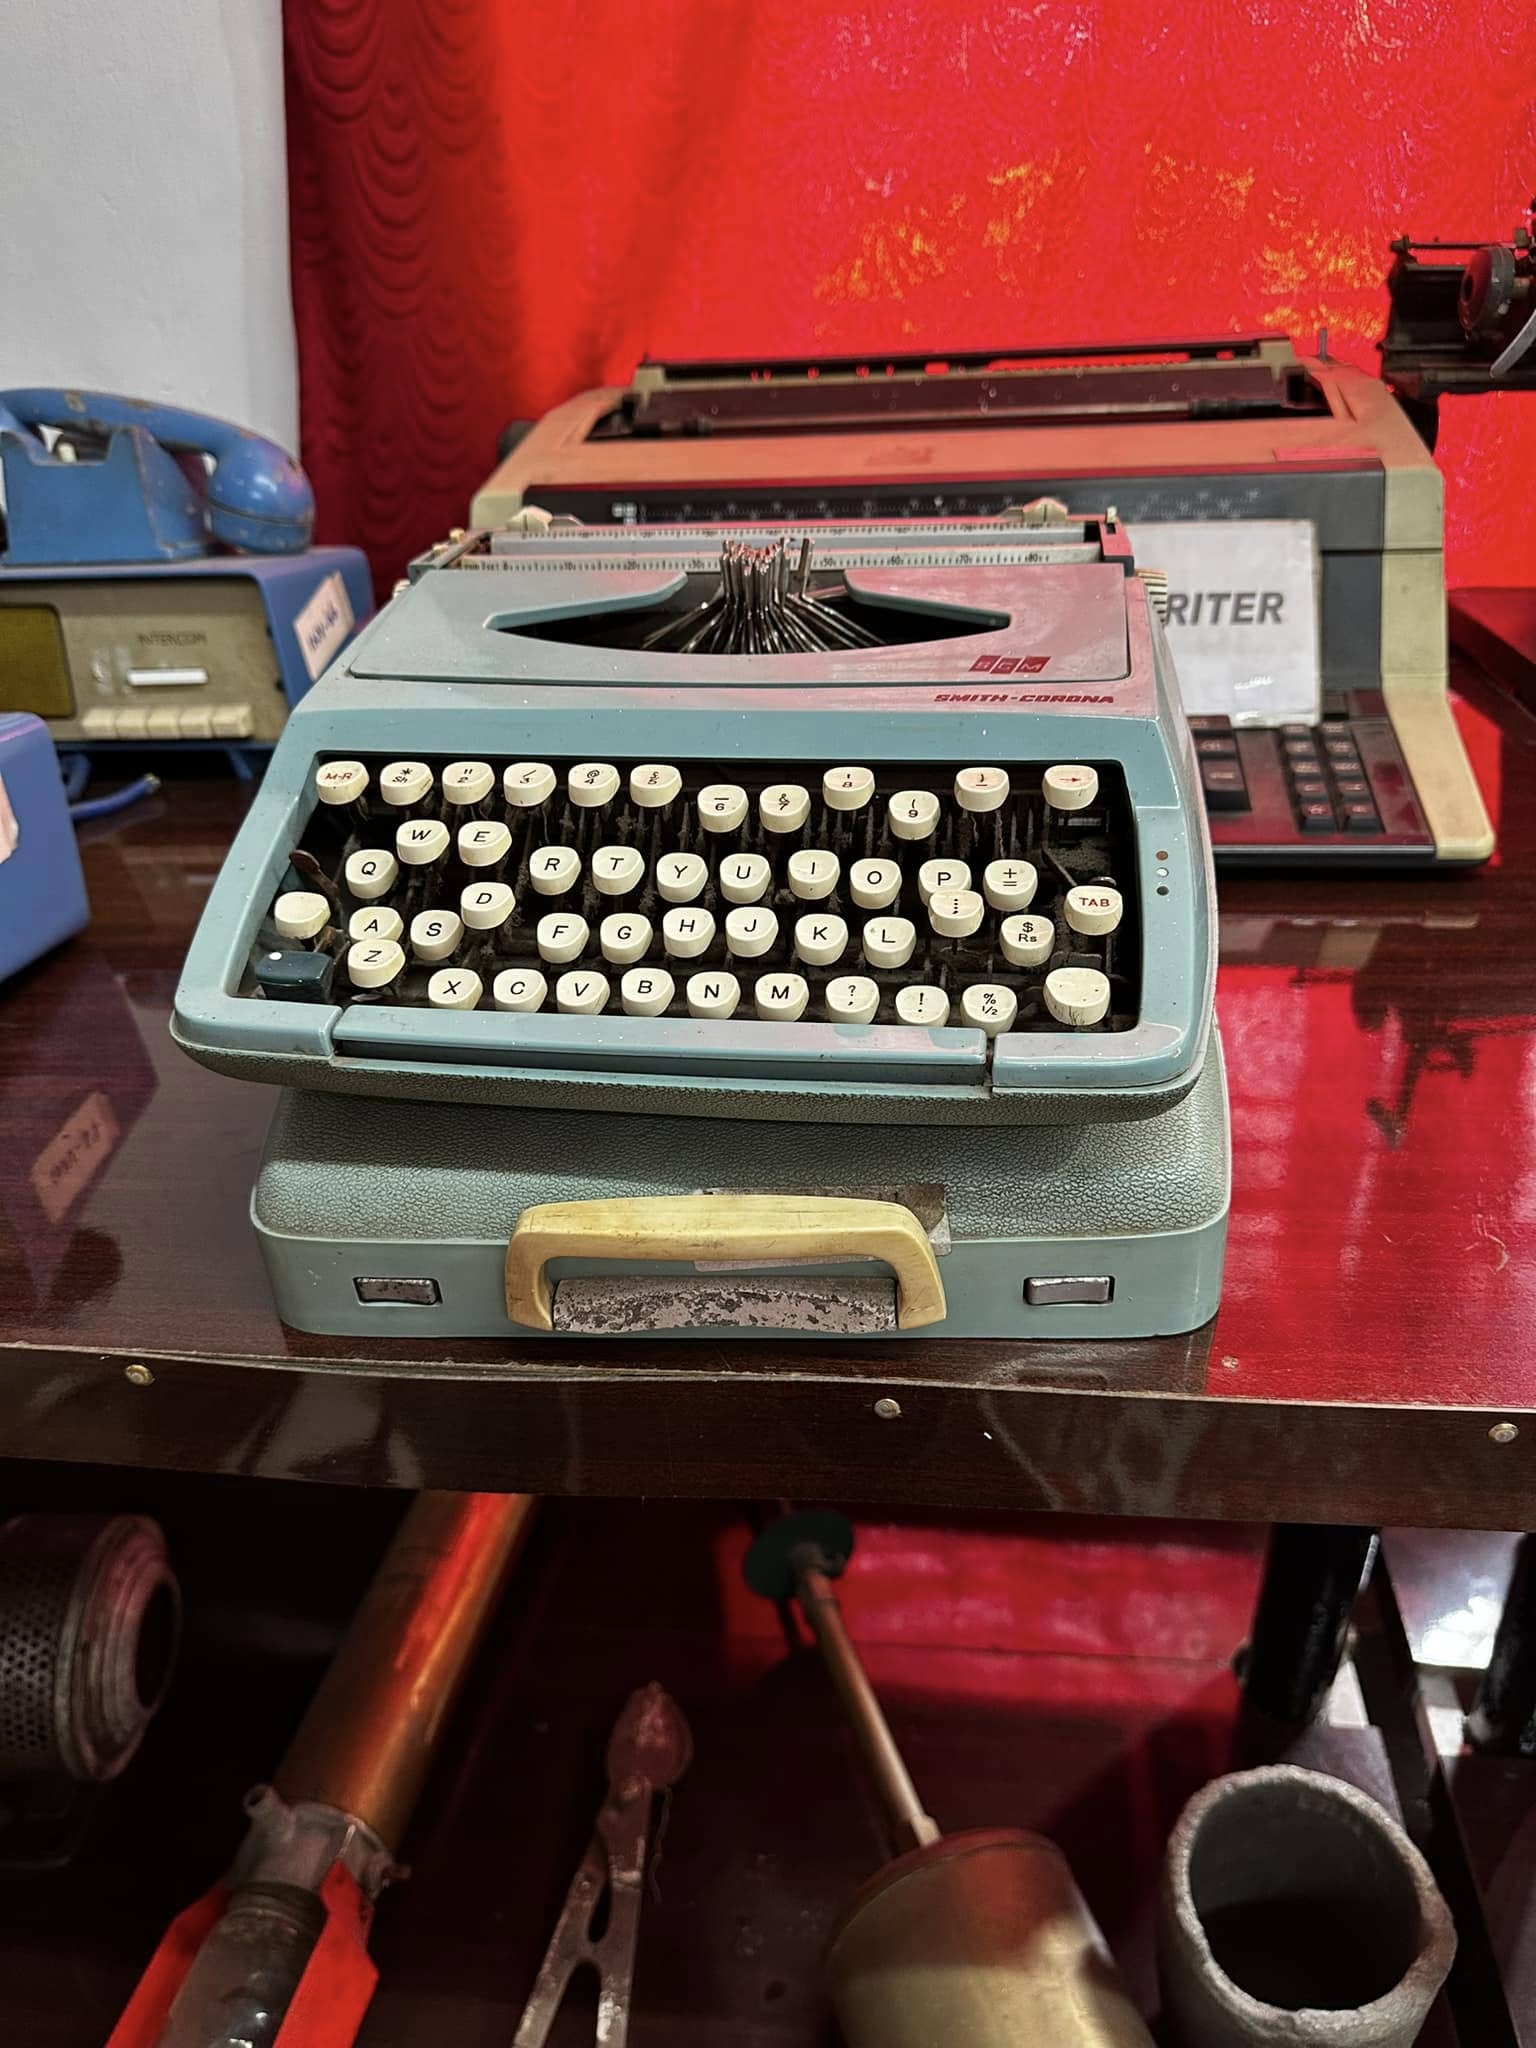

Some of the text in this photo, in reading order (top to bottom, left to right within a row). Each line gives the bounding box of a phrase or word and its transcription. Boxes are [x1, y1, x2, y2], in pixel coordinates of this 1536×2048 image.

[933, 693, 1115, 704] SMITH-CORONA
[586, 769, 601, 780] @
[714, 802, 725, 811] 6
[908, 809, 919, 818] 9
[411, 829, 432, 841] W
[472, 830, 491, 843] E
[361, 861, 377, 876] Q
[543, 857, 561, 872] R
[609, 857, 625, 871] T
[674, 864, 689, 879] Y
[811, 861, 816, 875] I
[736, 865, 752, 880] U
[866, 870, 883, 885] O
[937, 871, 952, 887] P
[475, 892, 493, 905] D
[1079, 897, 1110, 907] TAB
[363, 918, 379, 933] A
[425, 922, 443, 937] S
[551, 924, 569, 939] F
[617, 925, 632, 940] G
[679, 919, 696, 933] H
[743, 918, 757, 933] J
[1021, 921, 1035, 934] $
[812, 926, 828, 941] K
[881, 928, 896, 944] L
[1017, 933, 1038, 943] Rs
[362, 949, 383, 963] Z
[442, 980, 462, 995] X
[510, 981, 526, 996] C
[574, 982, 590, 997] V
[637, 979, 653, 994] B
[703, 983, 720, 999] N
[770, 985, 790, 1000] M
[847, 984, 858, 998] ?
[919, 992, 925, 1006] !
[983, 992, 997, 1005] %
